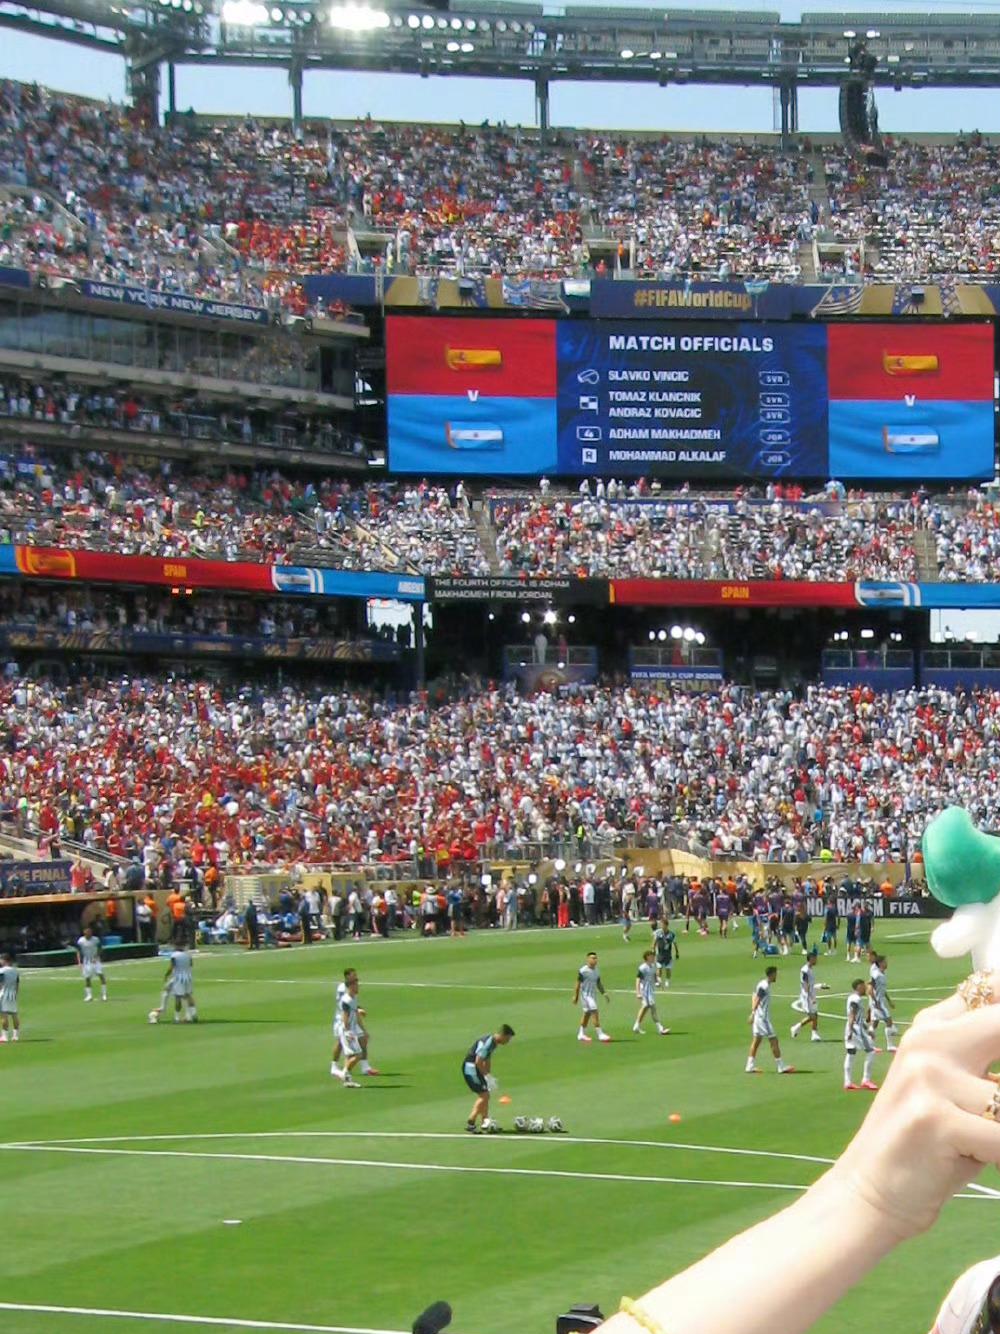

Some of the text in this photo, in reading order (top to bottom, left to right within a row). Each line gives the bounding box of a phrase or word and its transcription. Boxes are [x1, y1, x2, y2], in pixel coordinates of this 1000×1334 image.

[90, 283, 124, 298] NEW
[171, 298, 204, 314] NEW
[206, 303, 261, 320] JERSEY
[634, 289, 752, 311] #FIFAWorldCup
[609, 335, 774, 352] MATCH OFFICIALS
[608, 370, 689, 382] SLAVKO VINCIC
[608, 391, 646, 401] TOMAZ
[608, 407, 702, 418] ANDRAZ KOVACIC
[609, 428, 721, 440] ADHAM MAKHADMEH
[609, 450, 675, 461] MOHAMMAD
[721, 586, 750, 599] SPAIN
[806, 897, 824, 917] NO
[889, 901, 921, 915] FIFA
